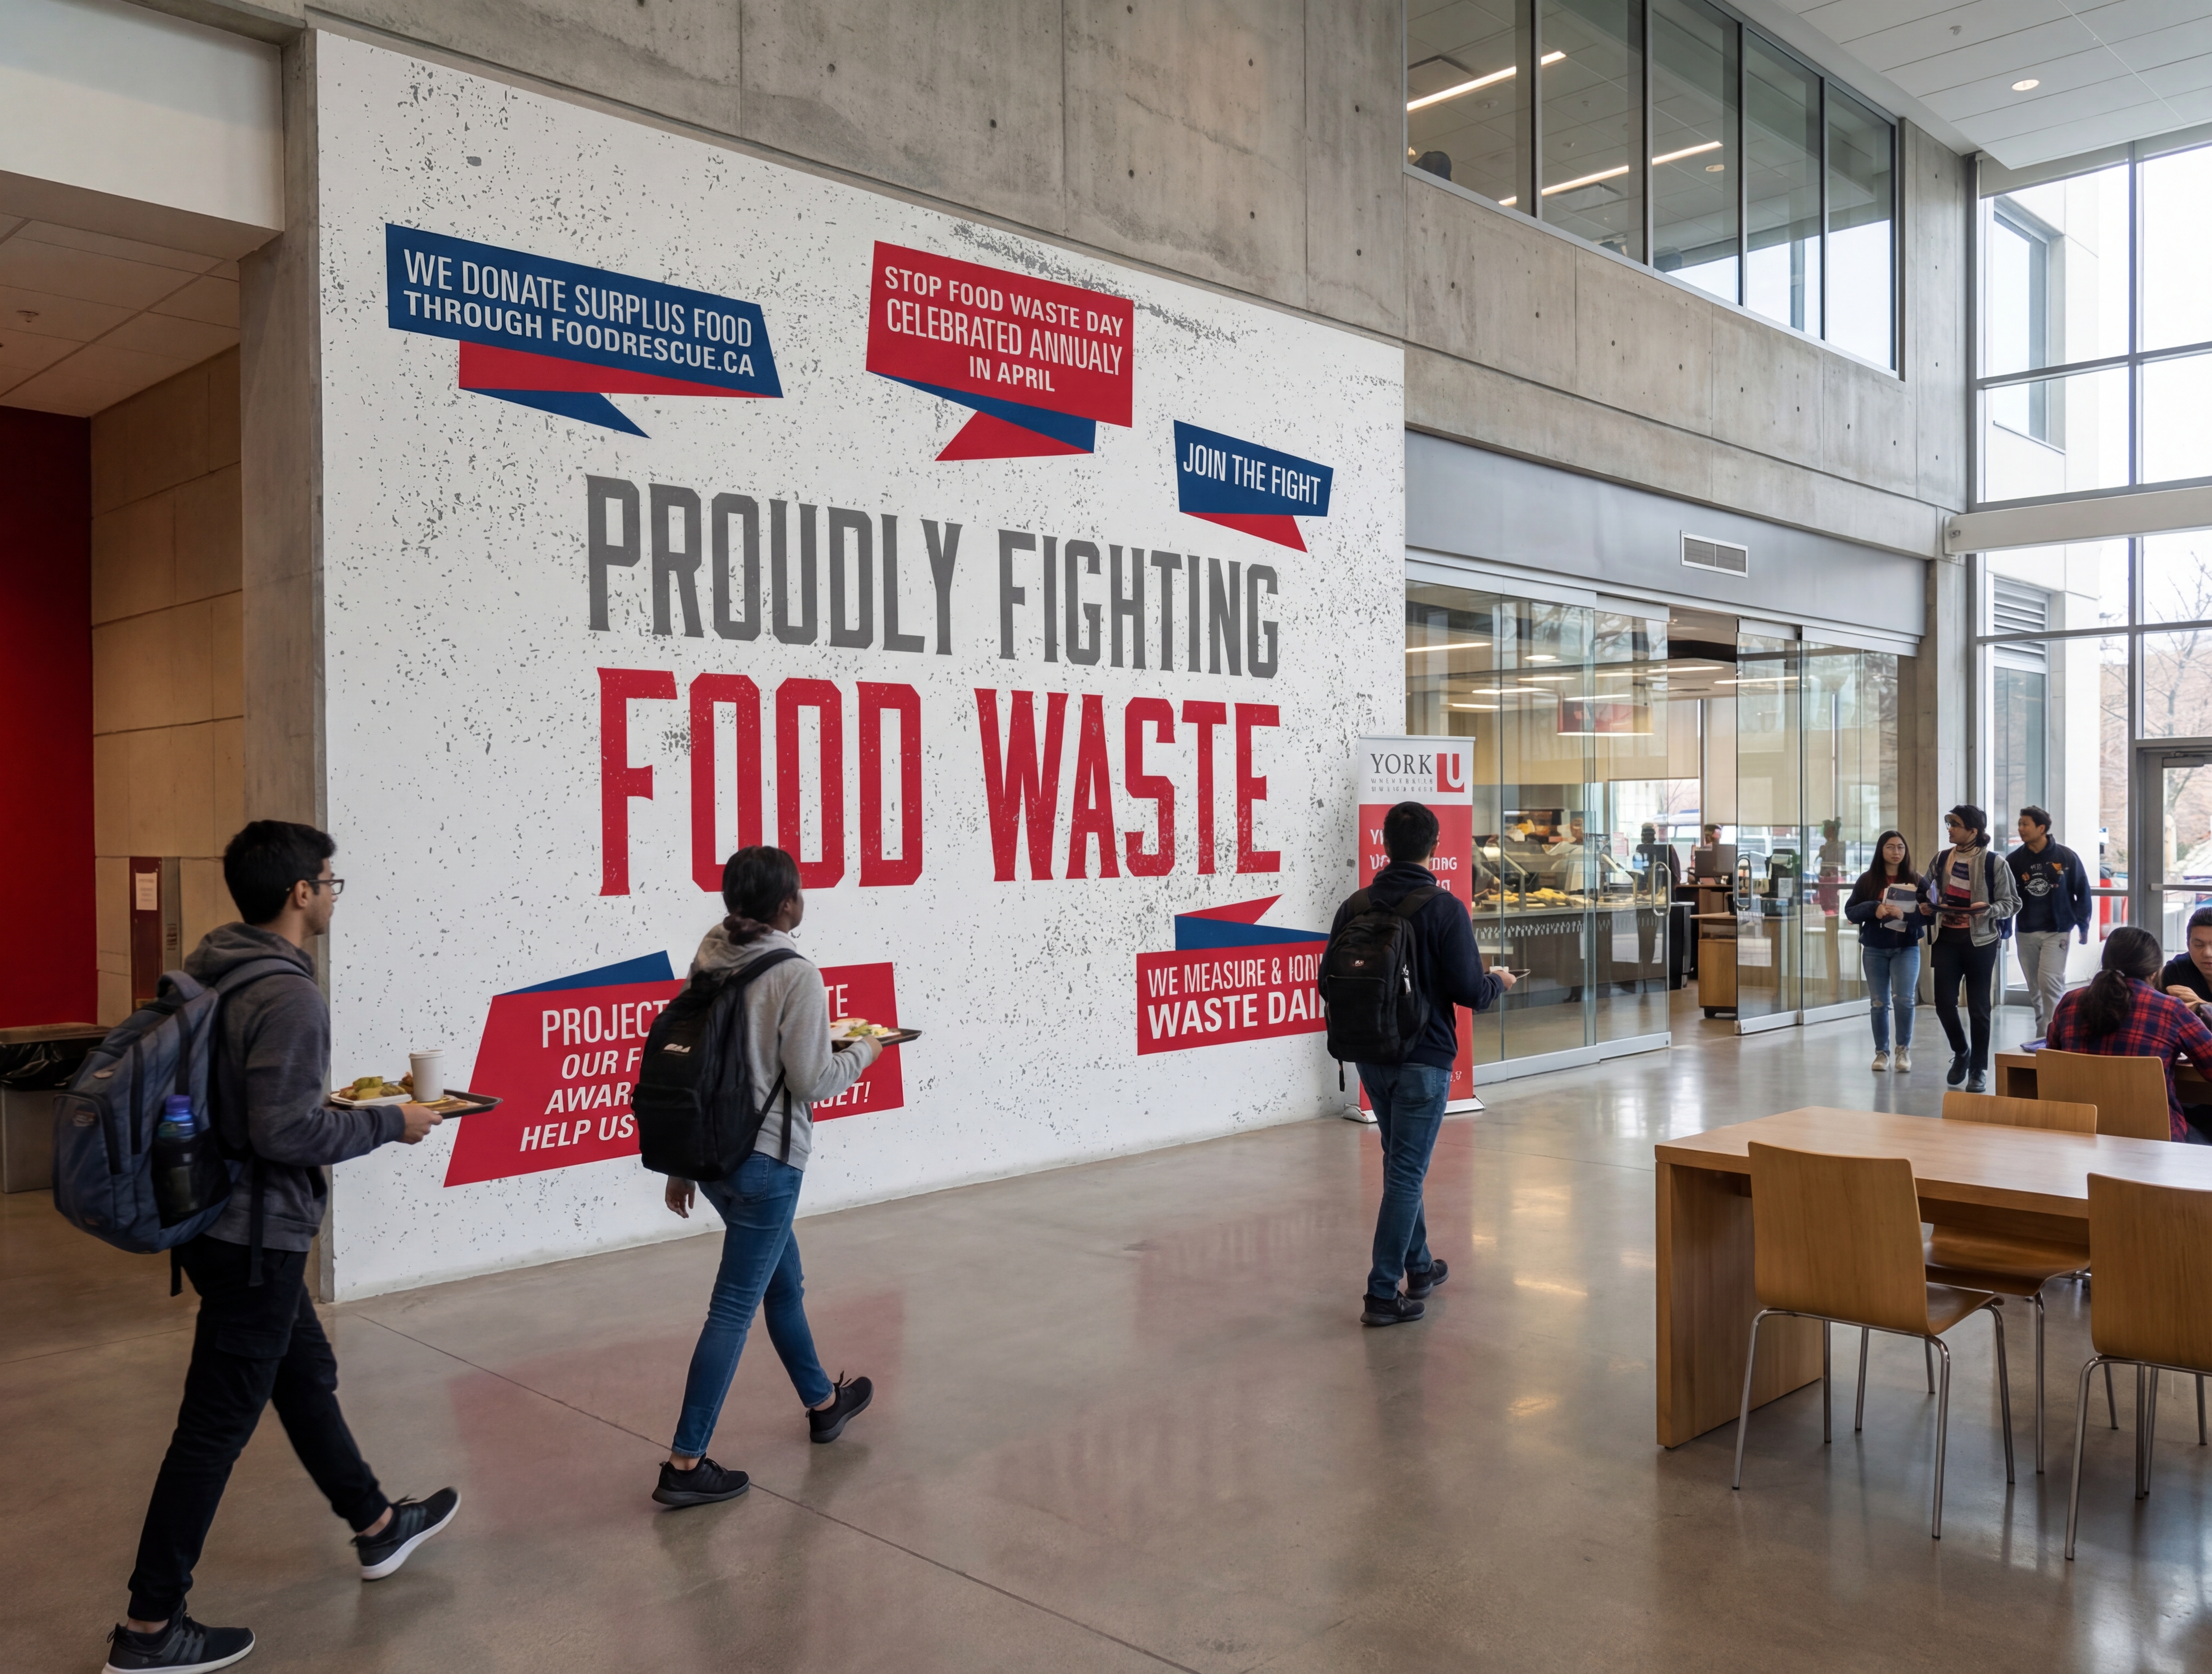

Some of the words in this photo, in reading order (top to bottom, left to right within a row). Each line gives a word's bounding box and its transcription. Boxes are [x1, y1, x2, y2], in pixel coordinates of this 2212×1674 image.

[404, 249, 452, 290] WE
[463, 262, 566, 312] DONATE
[575, 285, 684, 334] SURPLUS
[695, 308, 751, 347] FOOD
[886, 266, 941, 297] STOP
[950, 280, 1003, 311] FOOD
[1010, 293, 1079, 328] WASTE
[1087, 311, 1123, 337] DAY
[404, 291, 541, 338] THROUGH
[553, 319, 754, 376] FOODRESCUE.CA
[887, 298, 1021, 355] CELEBRATED
[1029, 329, 1122, 375] ANNUALY
[970, 356, 990, 380] IN
[998, 362, 1055, 391] APRIL
[1184, 443, 1226, 481] JOIN
[1232, 454, 1266, 491] THE
[1272, 466, 1320, 504] FIGHT
[585, 473, 963, 655] PROUDLY
[998, 529, 1278, 679] FIGHTING
[597, 667, 922, 896] FOOD
[974, 688, 1281, 881] WASTE
[1371, 754, 1432, 774] YORK
[1148, 967, 1177, 997] WE
[1185, 959, 1265, 993] MEASURE
[1272, 958, 1282, 984] &
[1148, 993, 1257, 1039] WASTE
[562, 1050, 618, 1079] OUR
[545, 1082, 632, 1114] AWAR
[520, 1120, 591, 1151] HELP
[599, 1114, 635, 1140] US
